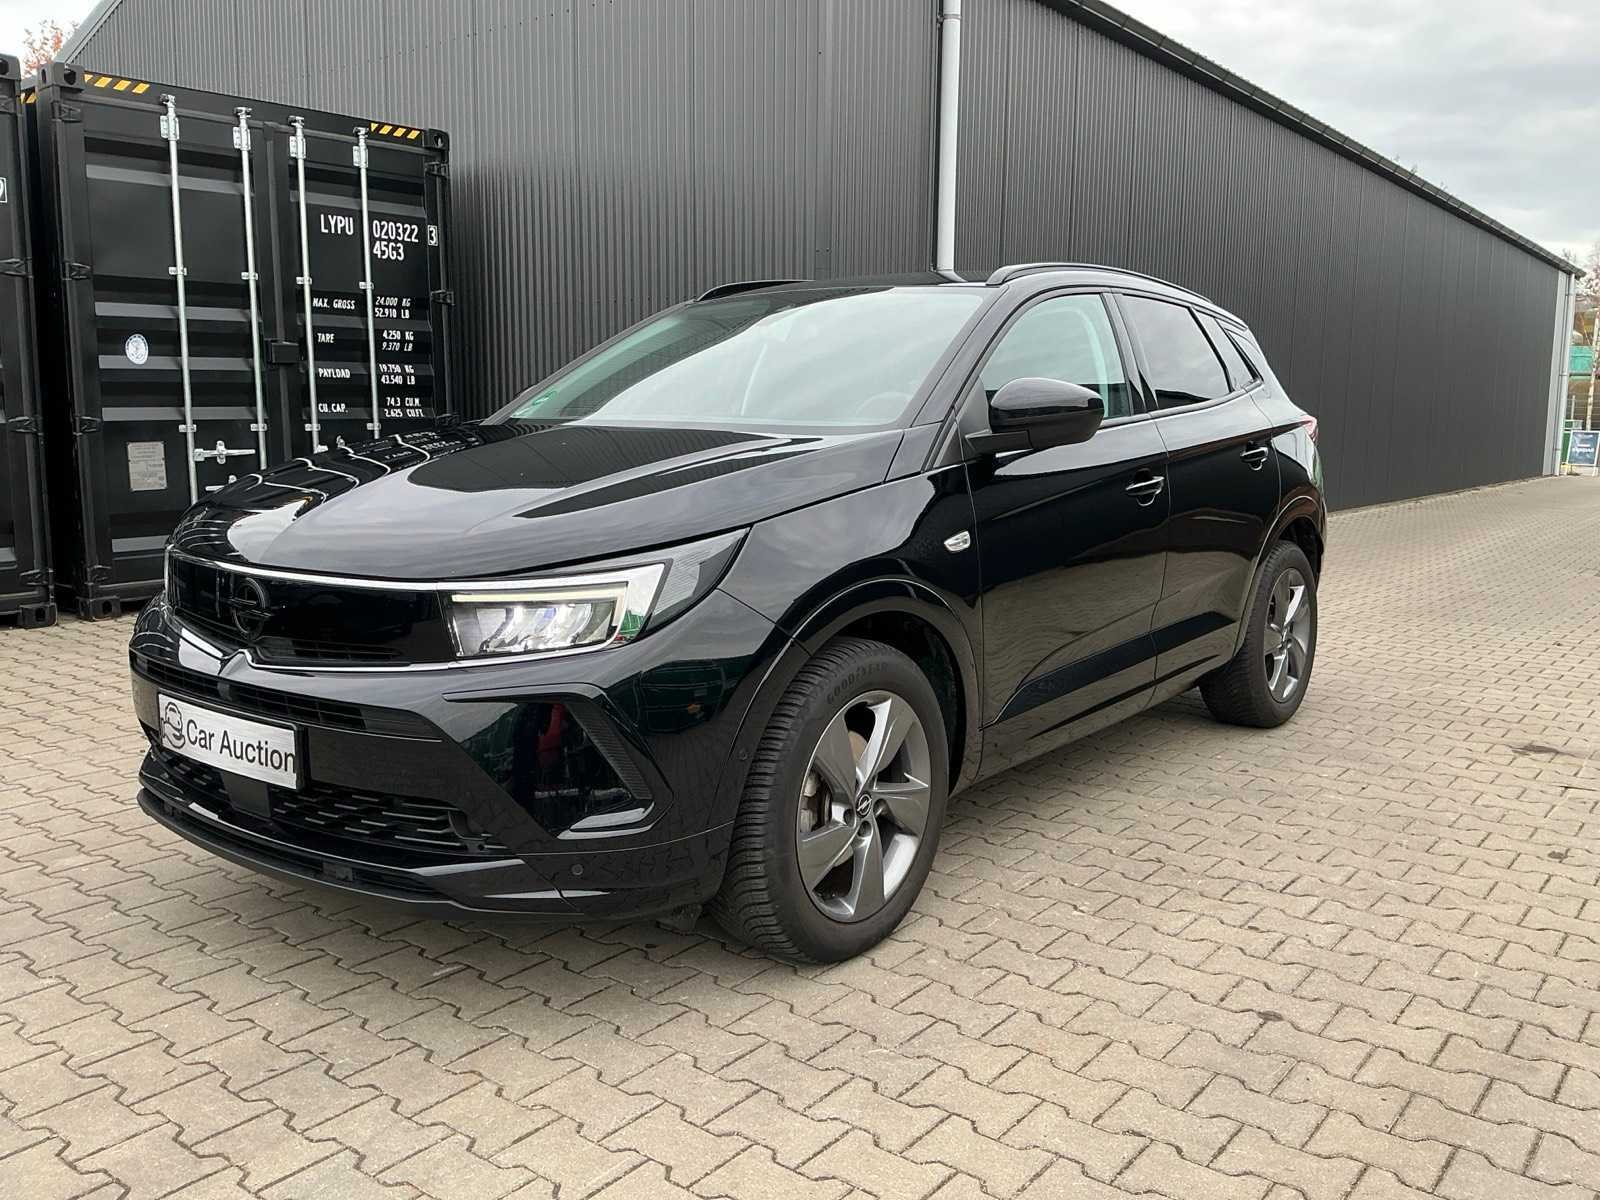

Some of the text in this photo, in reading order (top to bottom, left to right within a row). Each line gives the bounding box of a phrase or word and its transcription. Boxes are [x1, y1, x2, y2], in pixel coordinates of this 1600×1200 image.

[320, 214, 354, 236] LYPU
[373, 220, 419, 243] 020322
[373, 241, 404, 261] 45G3
[313, 298, 330, 309] MAX.
[333, 299, 355, 310] GROSS
[402, 298, 411, 307] KG
[375, 308, 410, 319] 52.910 LB
[317, 333, 335, 343] TARE
[405, 332, 414, 341] KG
[382, 342, 413, 352] 9.370 LB
[318, 368, 350, 379] PAYLOAD
[405, 365, 414, 374] KG
[407, 375, 415, 385] LB
[186, 719, 296, 774] Car Auction
